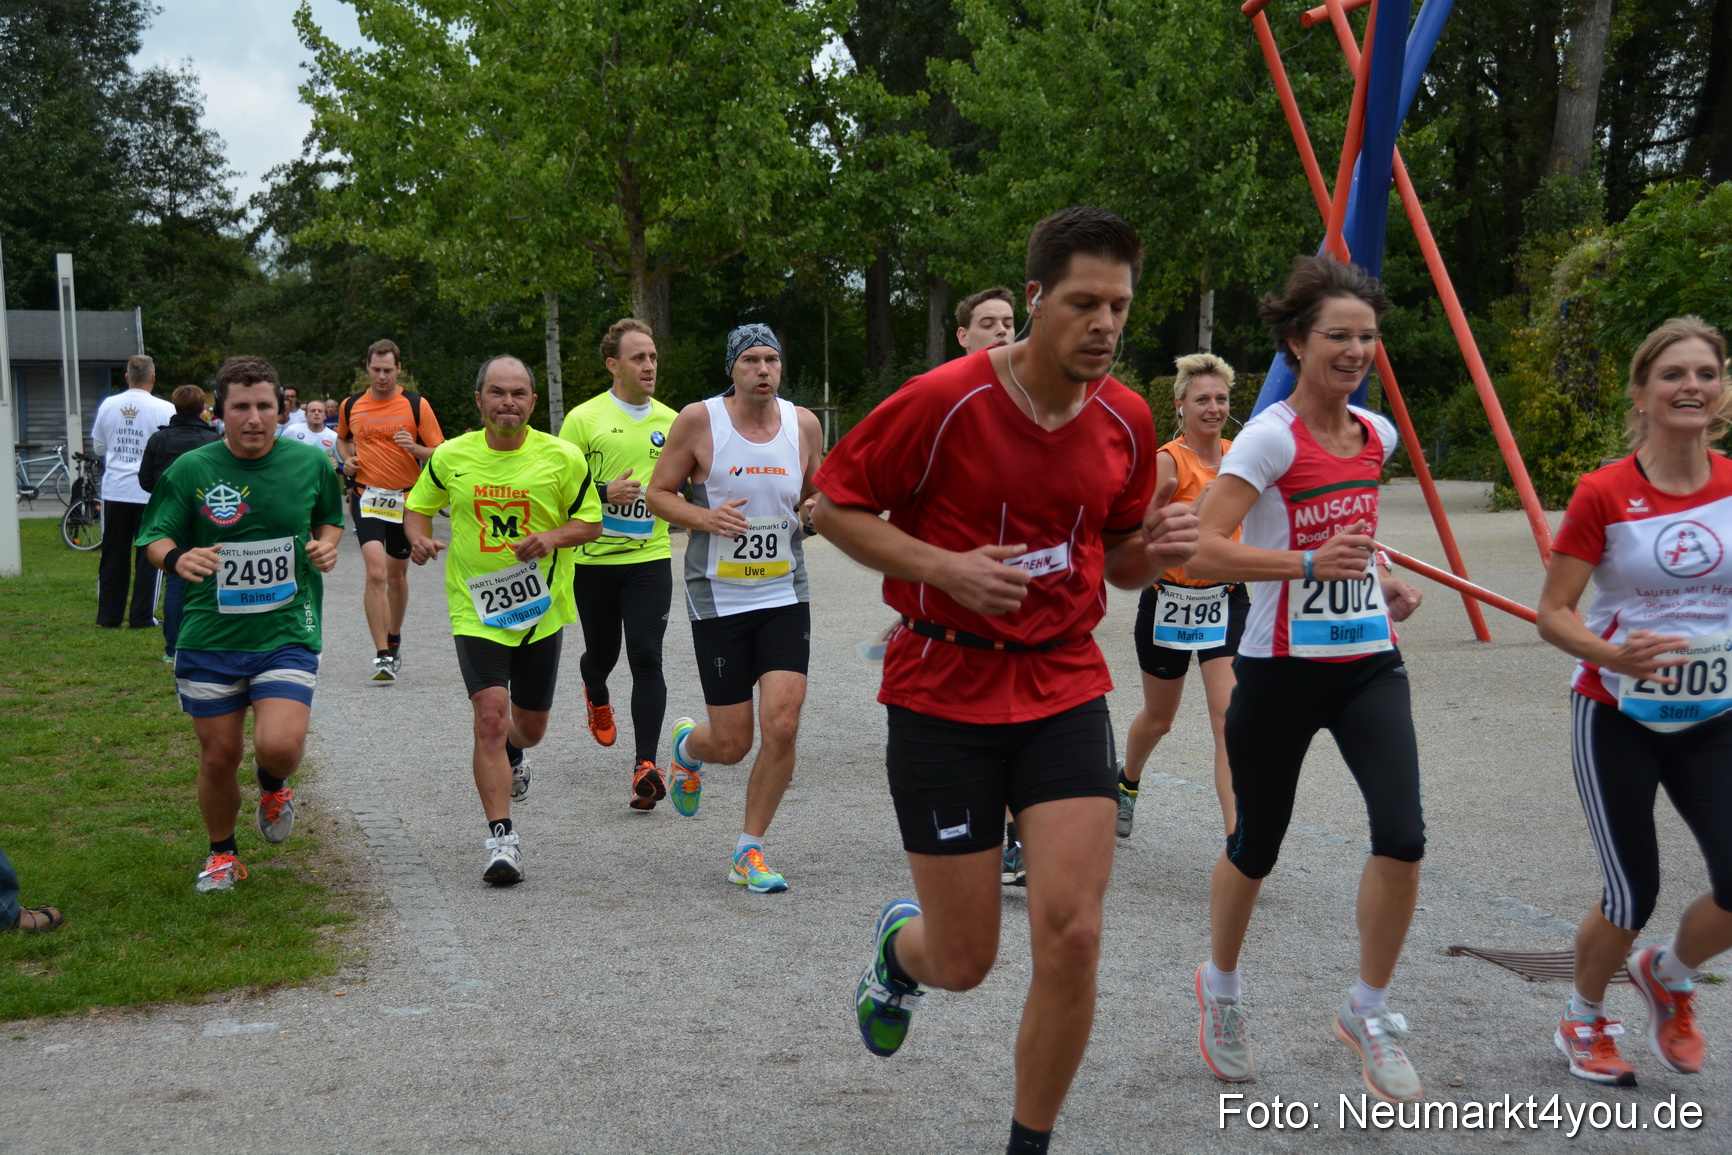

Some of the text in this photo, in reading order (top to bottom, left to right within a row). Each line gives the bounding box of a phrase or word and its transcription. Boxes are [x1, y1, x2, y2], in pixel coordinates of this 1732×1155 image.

[117, 437, 140, 446] SEINER
[119, 456, 137, 464] JESUS
[745, 466, 790, 476] KLEBL
[473, 485, 530, 499] Müller
[371, 496, 397, 508] 170
[1295, 494, 1373, 529] MUSCAT
[489, 515, 520, 538] M
[747, 523, 780, 531] Neumarkt
[1296, 526, 1330, 546] Road
[217, 546, 281, 557] PARTL Neumarkt
[733, 533, 778, 560] 239
[224, 555, 289, 586] 2498
[744, 566, 766, 576] Uwe
[470, 567, 528, 591] PARTL Neumarkt
[241, 592, 276, 603] Rainer
[480, 574, 542, 615] 2390
[1160, 590, 1184, 600] PARTL
[1302, 572, 1378, 615] 2002
[1635, 587, 1680, 597] LAUFEN
[1684, 585, 1707, 594] MIT
[497, 604, 541, 627] Wolfgang
[1163, 601, 1221, 625] 2198
[1177, 630, 1204, 640] Maria
[1330, 624, 1364, 642] Birgit
[1670, 643, 1721, 655] Neumarkt
[1659, 705, 1700, 719] Steffi
